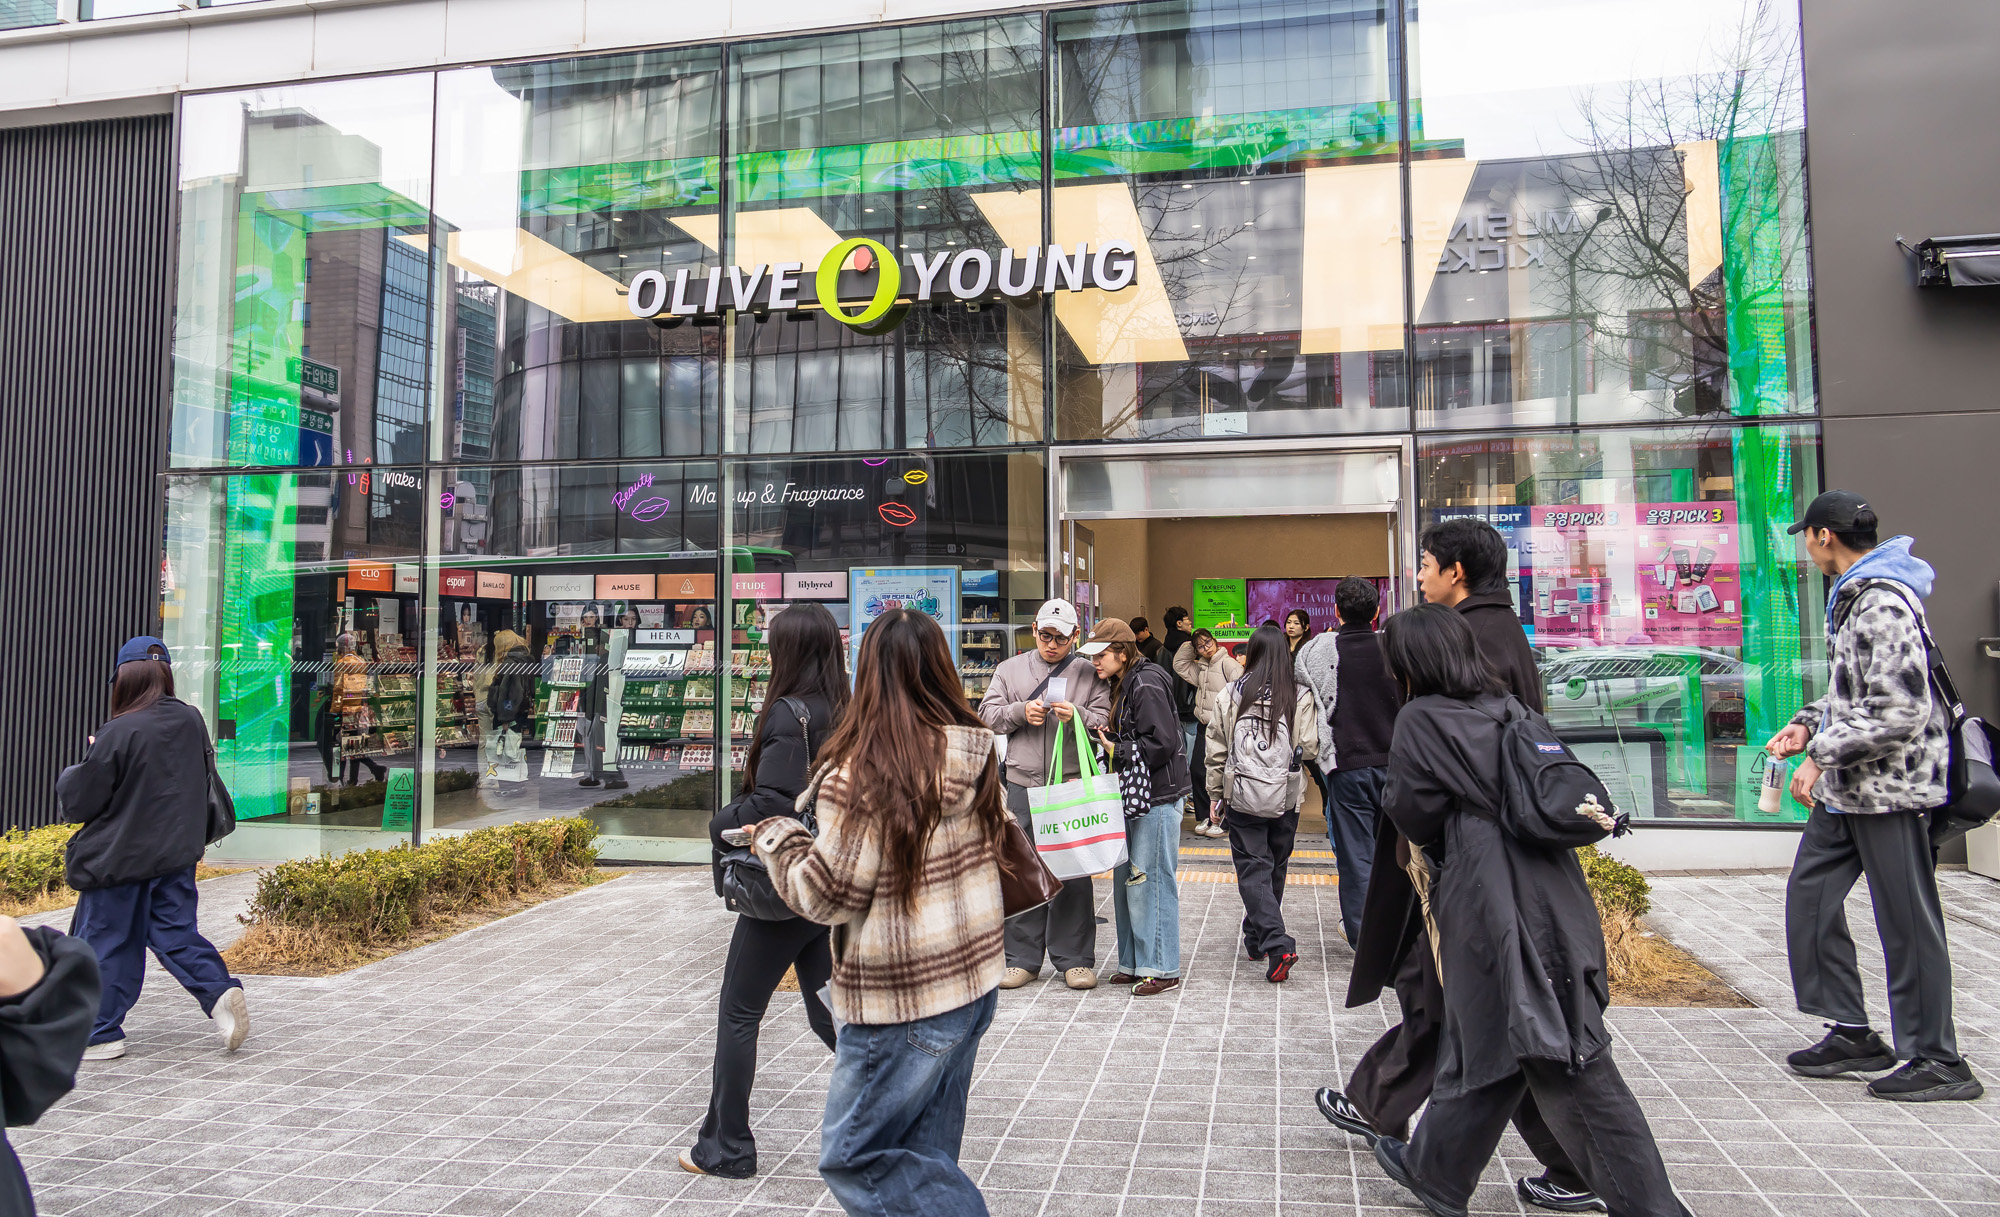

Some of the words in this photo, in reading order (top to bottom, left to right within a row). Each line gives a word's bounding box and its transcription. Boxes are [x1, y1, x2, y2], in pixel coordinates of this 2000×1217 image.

[627, 261, 803, 318] OLIVE
[910, 239, 1138, 301] YOUNG
[382, 472, 415, 488] Make
[611, 472, 656, 512] Beauty
[737, 490, 757, 509] up
[761, 484, 777, 504] &
[780, 483, 865, 508] Fragrance
[1489, 513, 1522, 522] EDIT
[1543, 511, 1568, 527] 올영
[1569, 511, 1605, 527] PICK
[1606, 510, 1619, 526] 3
[1645, 509, 1672, 525] 올영
[1672, 508, 1709, 524] PICK
[1710, 508, 1724, 524] 3
[360, 568, 380, 578] CLIO
[446, 576, 466, 588] espoir
[482, 581, 498, 589] BANILA
[611, 583, 641, 591] AMUSE
[735, 581, 766, 590] ETUDE
[798, 580, 833, 590] lilybyred
[650, 632, 681, 640] HERA
[1614, 692, 1651, 708] K-BEAUTY
[1652, 686, 1670, 697] NOW
[1040, 822, 1059, 835] LIVE
[1063, 812, 1109, 832] YOUNG
